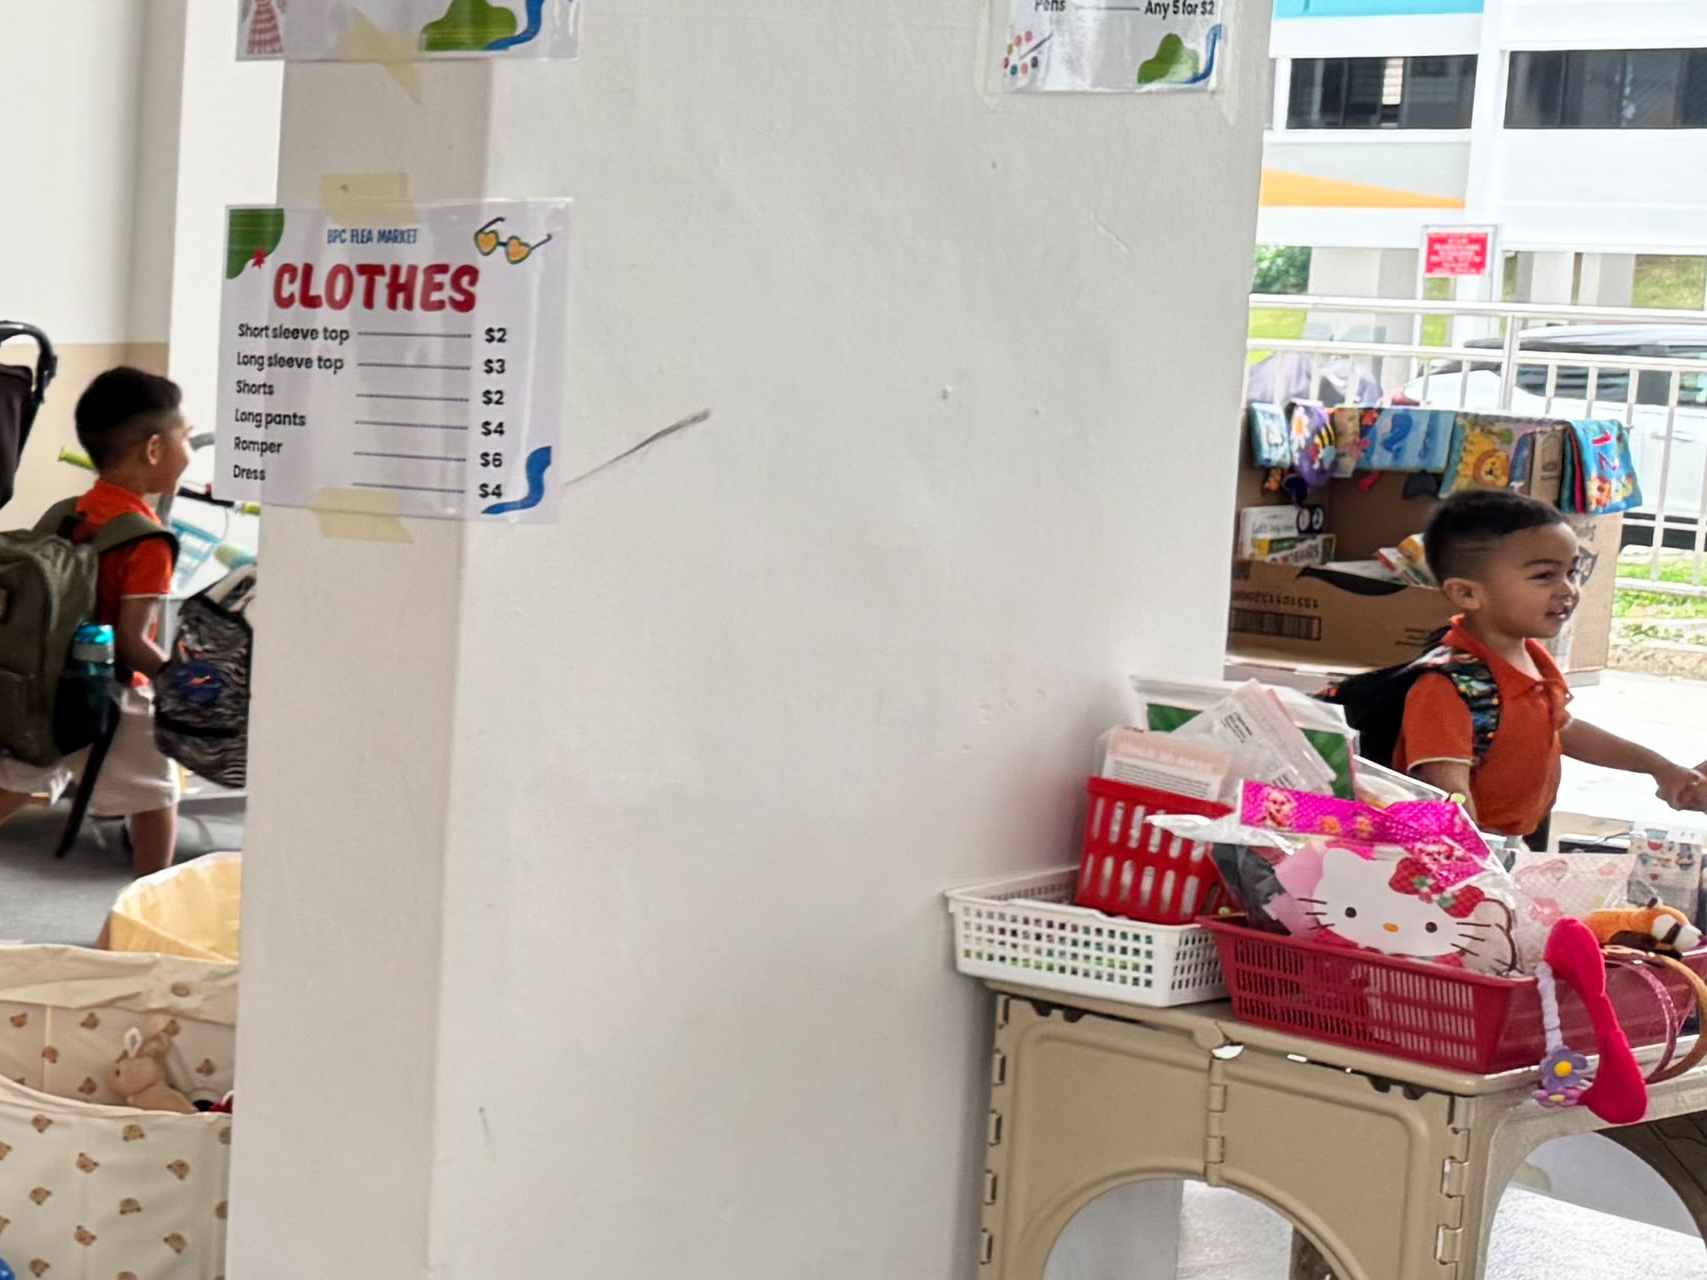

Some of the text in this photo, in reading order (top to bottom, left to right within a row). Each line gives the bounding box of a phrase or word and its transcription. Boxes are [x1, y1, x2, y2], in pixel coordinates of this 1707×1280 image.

[1172, 0, 1181, 15] 5
[1181, 0, 1199, 16] for
[1200, 0, 1215, 16] $2
[327, 228, 420, 246] BPC FLEA MARKET
[272, 262, 480, 313] CLOTHES
[238, 322, 508, 348] Short sleeve top $2
[236, 351, 507, 376] Long sleeve top $3
[235, 379, 505, 407] Shorts $2
[234, 408, 505, 438] Long pants $4
[233, 436, 503, 469] Romper $6
[232, 464, 503, 500] Dress $4
